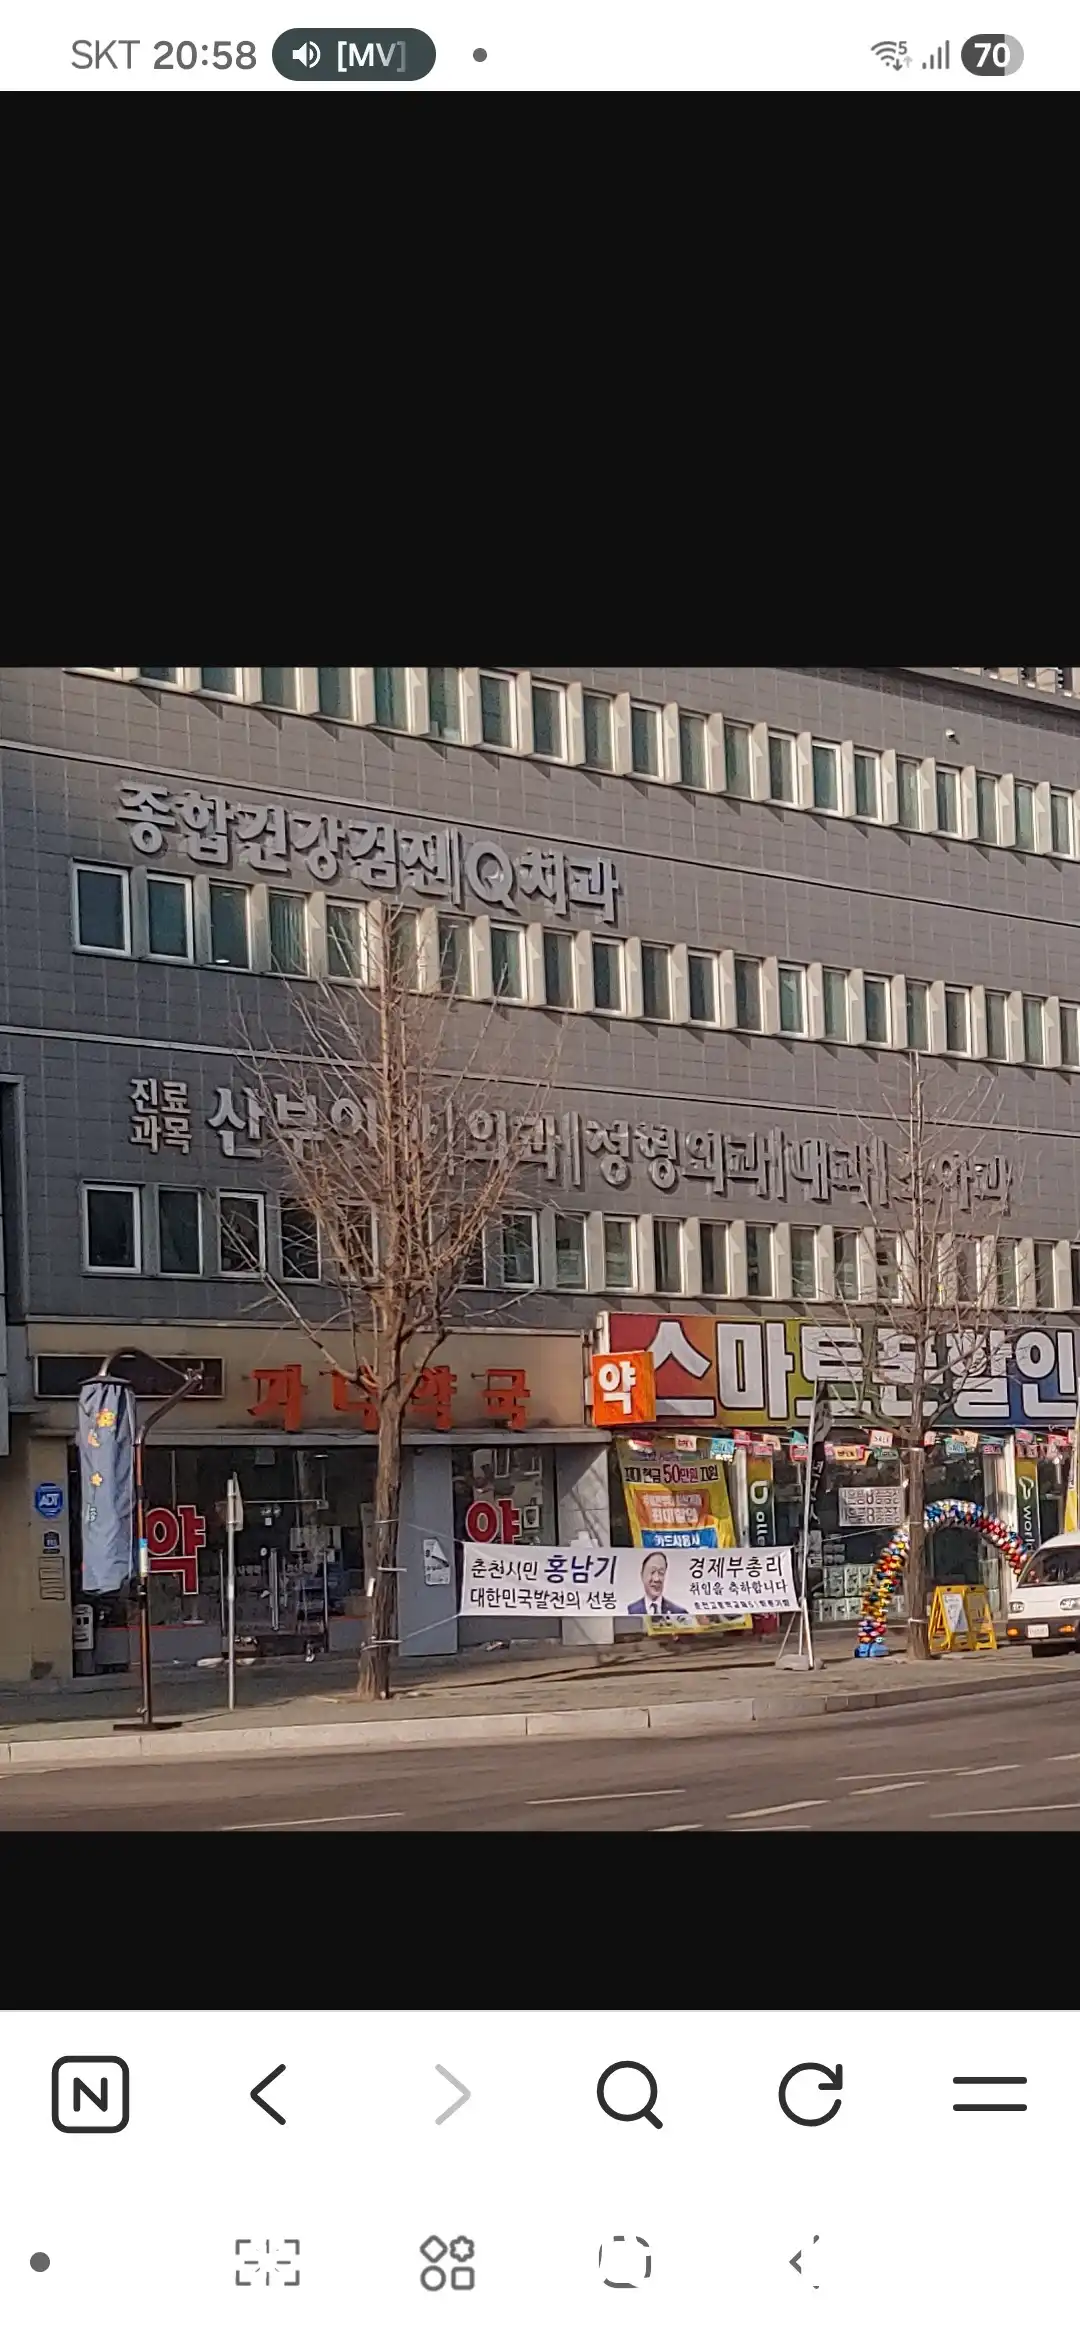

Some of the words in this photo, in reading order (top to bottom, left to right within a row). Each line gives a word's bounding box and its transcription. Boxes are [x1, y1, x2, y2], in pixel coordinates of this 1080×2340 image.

[71, 40, 140, 69] SKT
[153, 40, 257, 69] 20:58
[974, 43, 1011, 67] 70
[116, 780, 450, 896] 종합건강검진
[464, 841, 622, 923] Q치과
[129, 1078, 192, 1114] 진료
[129, 1115, 192, 1154] 과목
[462, 1109, 563, 1181] 외과
[585, 1119, 773, 1196] 정형외과
[785, 1137, 874, 1204] 내과
[598, 1360, 637, 1415] 약
[648, 1320, 1077, 1420] 스마트폰할인
[662, 1462, 699, 1484] 50만원
[700, 1463, 720, 1482] 지원
[146, 1505, 206, 1596] 약
[689, 1556, 782, 1578] 경제부총리
[471, 1558, 538, 1581] 춘천시민
[544, 1554, 617, 1584] 홍남기
[470, 1588, 581, 1610] 대한민국발전의
[586, 1591, 617, 1610] 선봉
[689, 1582, 724, 1595] 취임을
[728, 1579, 788, 1596] 축하합니다
[73, 2076, 108, 2112] N
